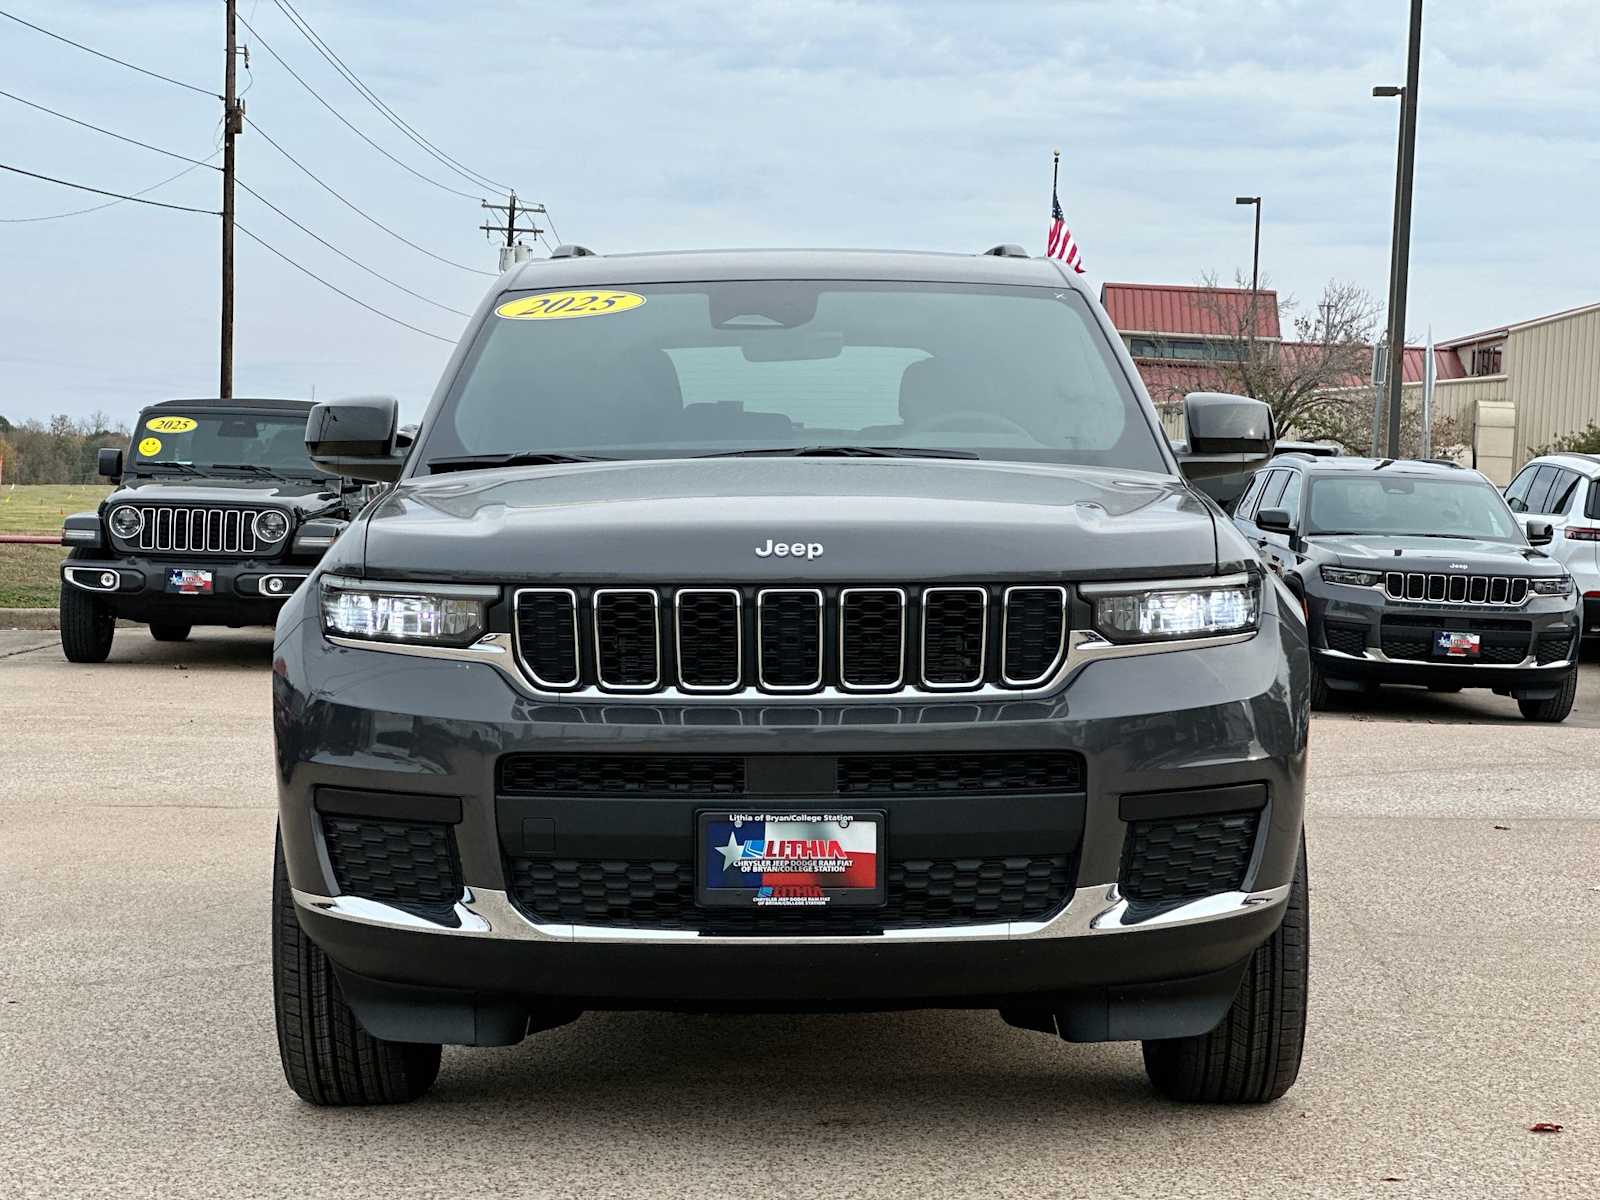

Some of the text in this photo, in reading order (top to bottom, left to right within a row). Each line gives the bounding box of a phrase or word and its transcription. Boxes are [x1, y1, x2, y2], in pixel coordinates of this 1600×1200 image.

[517, 295, 627, 316] 2025
[154, 420, 190, 429] 2025
[755, 539, 824, 559] Jeep
[765, 814, 822, 823] Bryan/College
[823, 814, 854, 822] Station
[764, 840, 848, 859] LITHIA
